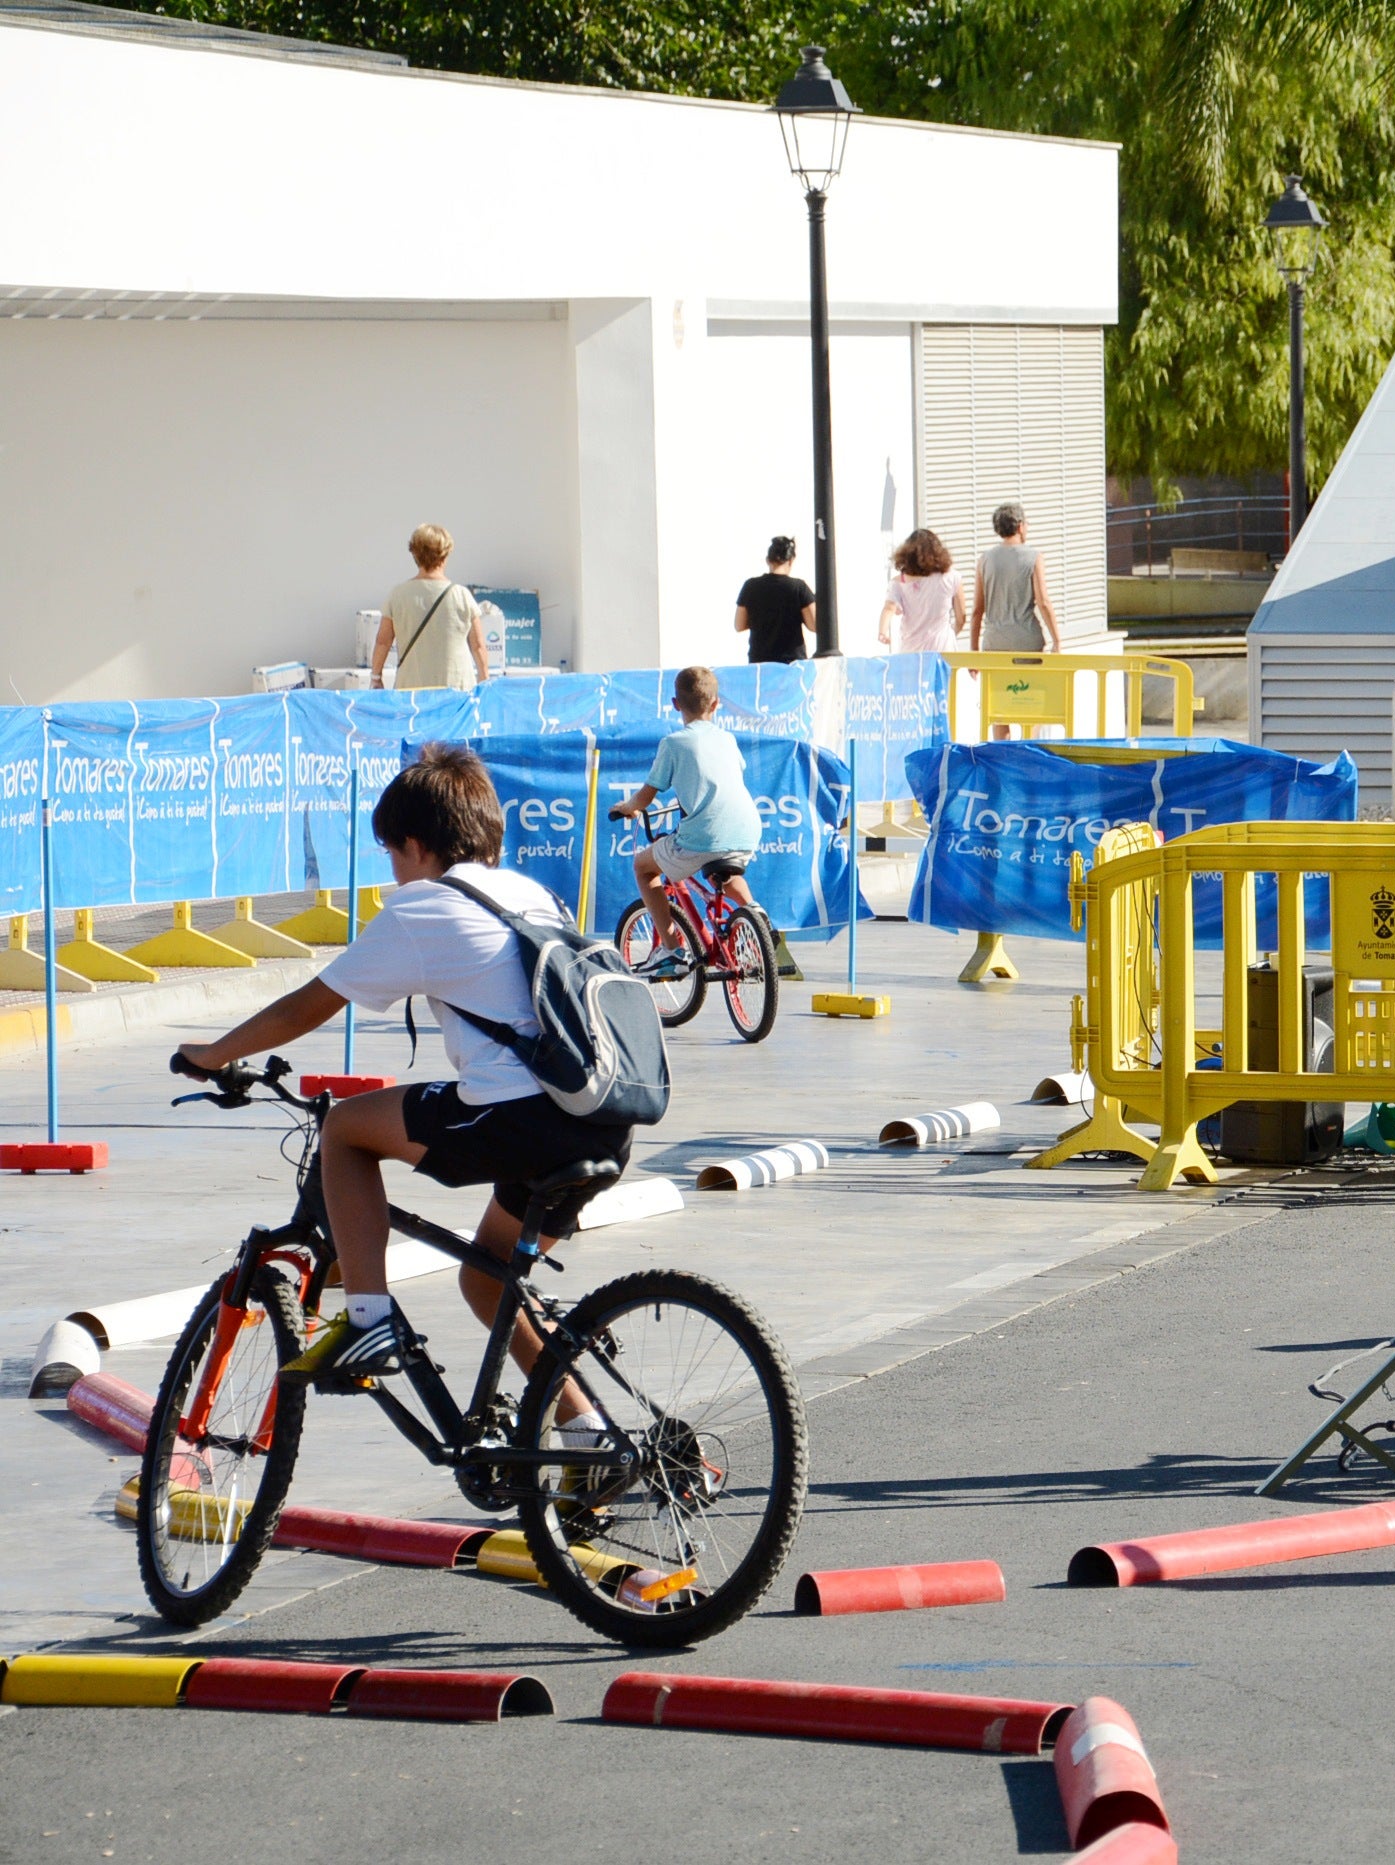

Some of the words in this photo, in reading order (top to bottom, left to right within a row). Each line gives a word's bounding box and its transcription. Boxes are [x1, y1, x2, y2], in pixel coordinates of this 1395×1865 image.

[51, 739, 129, 794] Tomares
[134, 741, 210, 792] Tomares
[218, 739, 283, 789] Tomares
[291, 736, 349, 788] Tomares
[947, 832, 1002, 860] ¡Como
[1010, 850, 1022, 863] a
[1029, 844, 1046, 864] ti
[1362, 951, 1372, 960] de
